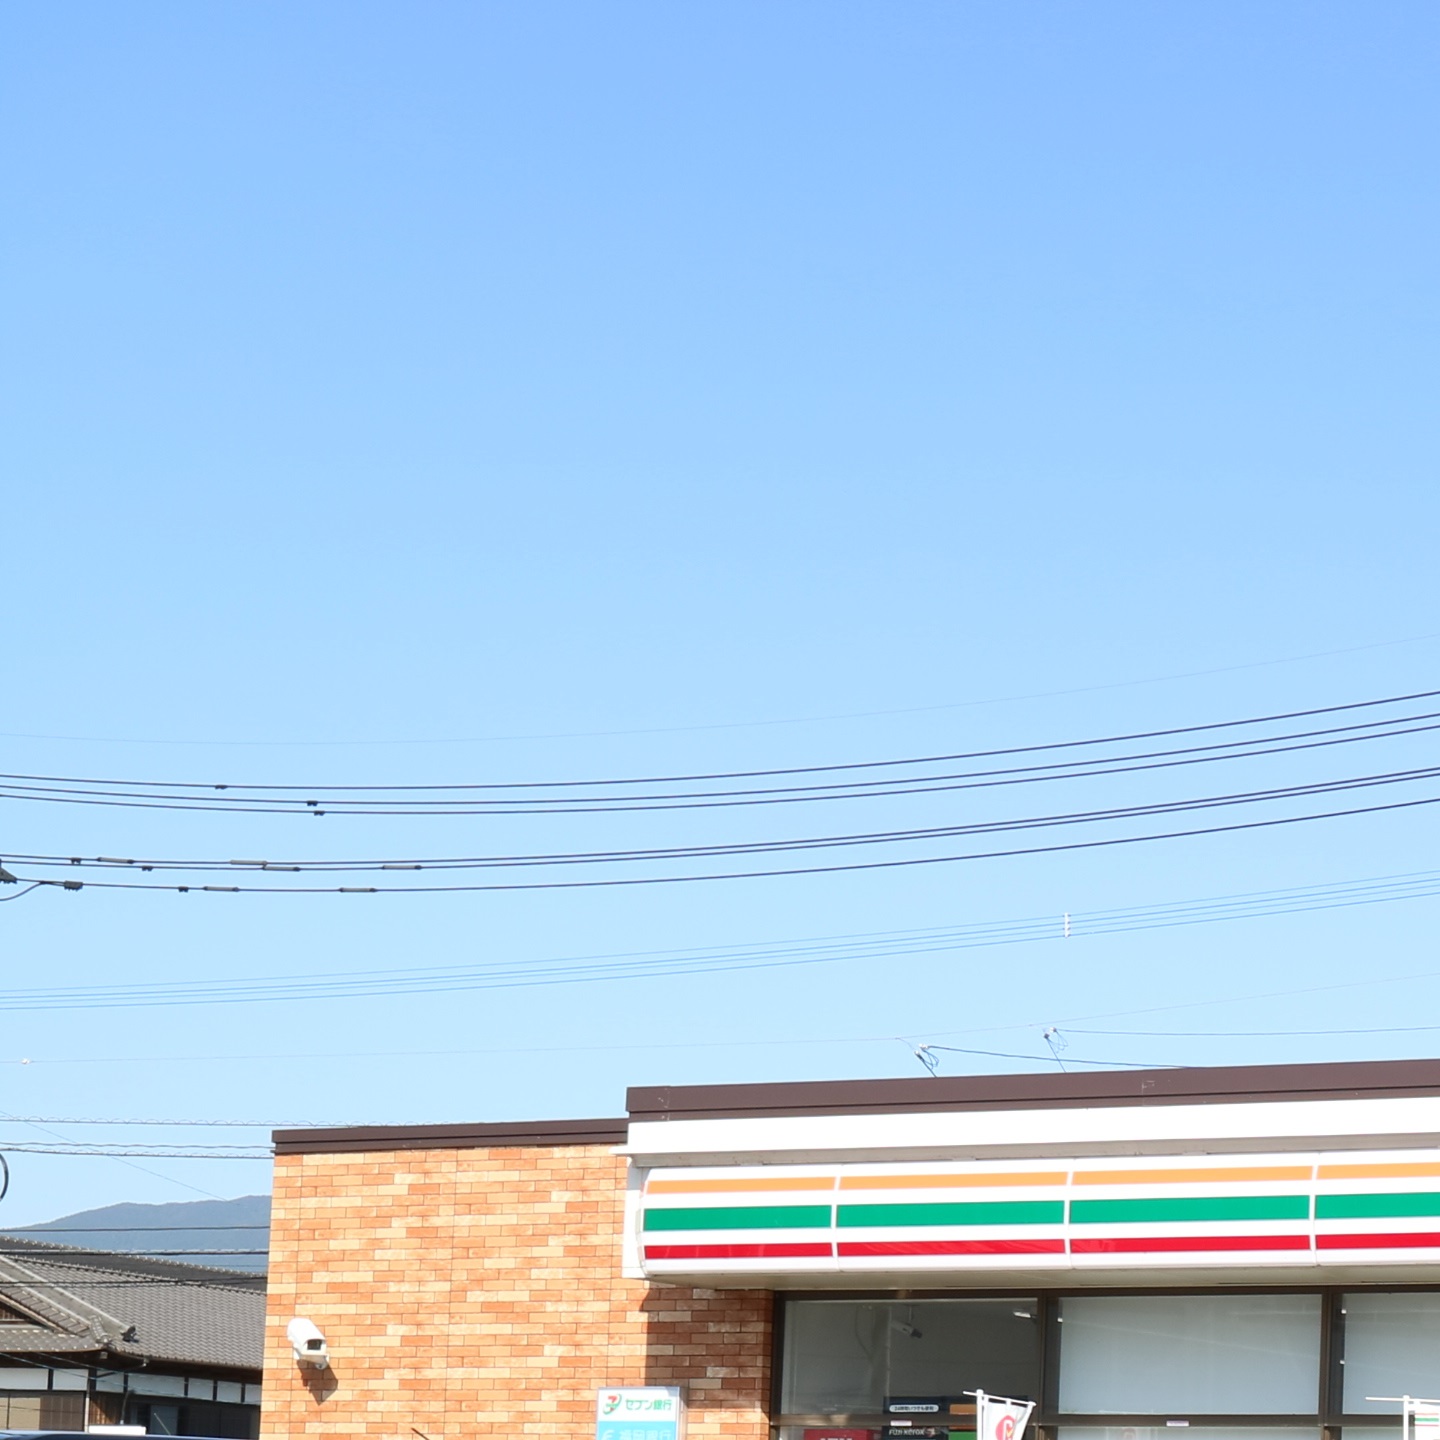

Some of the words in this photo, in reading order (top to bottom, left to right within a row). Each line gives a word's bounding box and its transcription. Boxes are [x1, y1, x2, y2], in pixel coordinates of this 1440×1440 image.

[625, 1400, 672, 1411] セブン銀行
